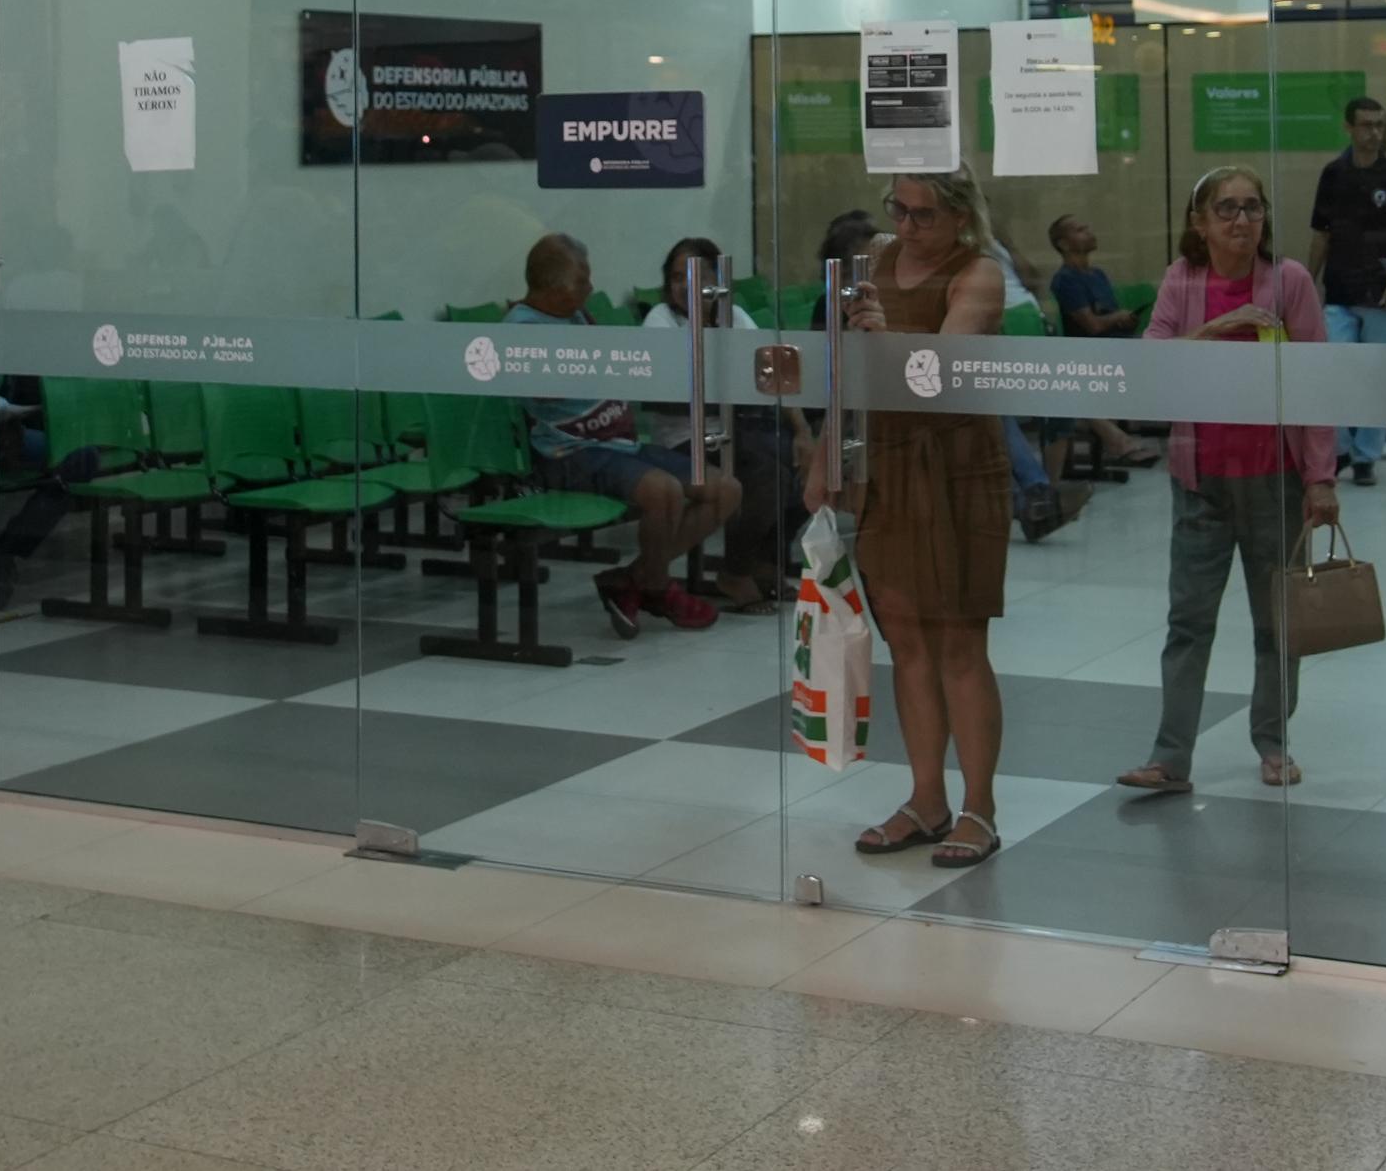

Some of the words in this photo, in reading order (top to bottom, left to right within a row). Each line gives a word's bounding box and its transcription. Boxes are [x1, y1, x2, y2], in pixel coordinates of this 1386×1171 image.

[144, 70, 167, 82] NÃO
[372, 65, 468, 85] DEFENSORIA
[469, 64, 529, 88] PÚBLICA
[133, 85, 181, 97] TIRAMOS
[1205, 86, 1260, 100] Valores
[372, 92, 394, 110] DO
[395, 92, 445, 110] ESTADO
[445, 93, 465, 110] DO
[465, 93, 529, 111] AMAZONAS
[563, 119, 678, 142] EMPURRE
[127, 348, 142, 358] DO
[143, 348, 182, 359] ESTADO
[952, 360, 1051, 375] DEFENSORIA
[1056, 361, 1126, 377] PÚBLICA
[974, 377, 1026, 390] ESTADO
[1028, 379, 1049, 391] DO
